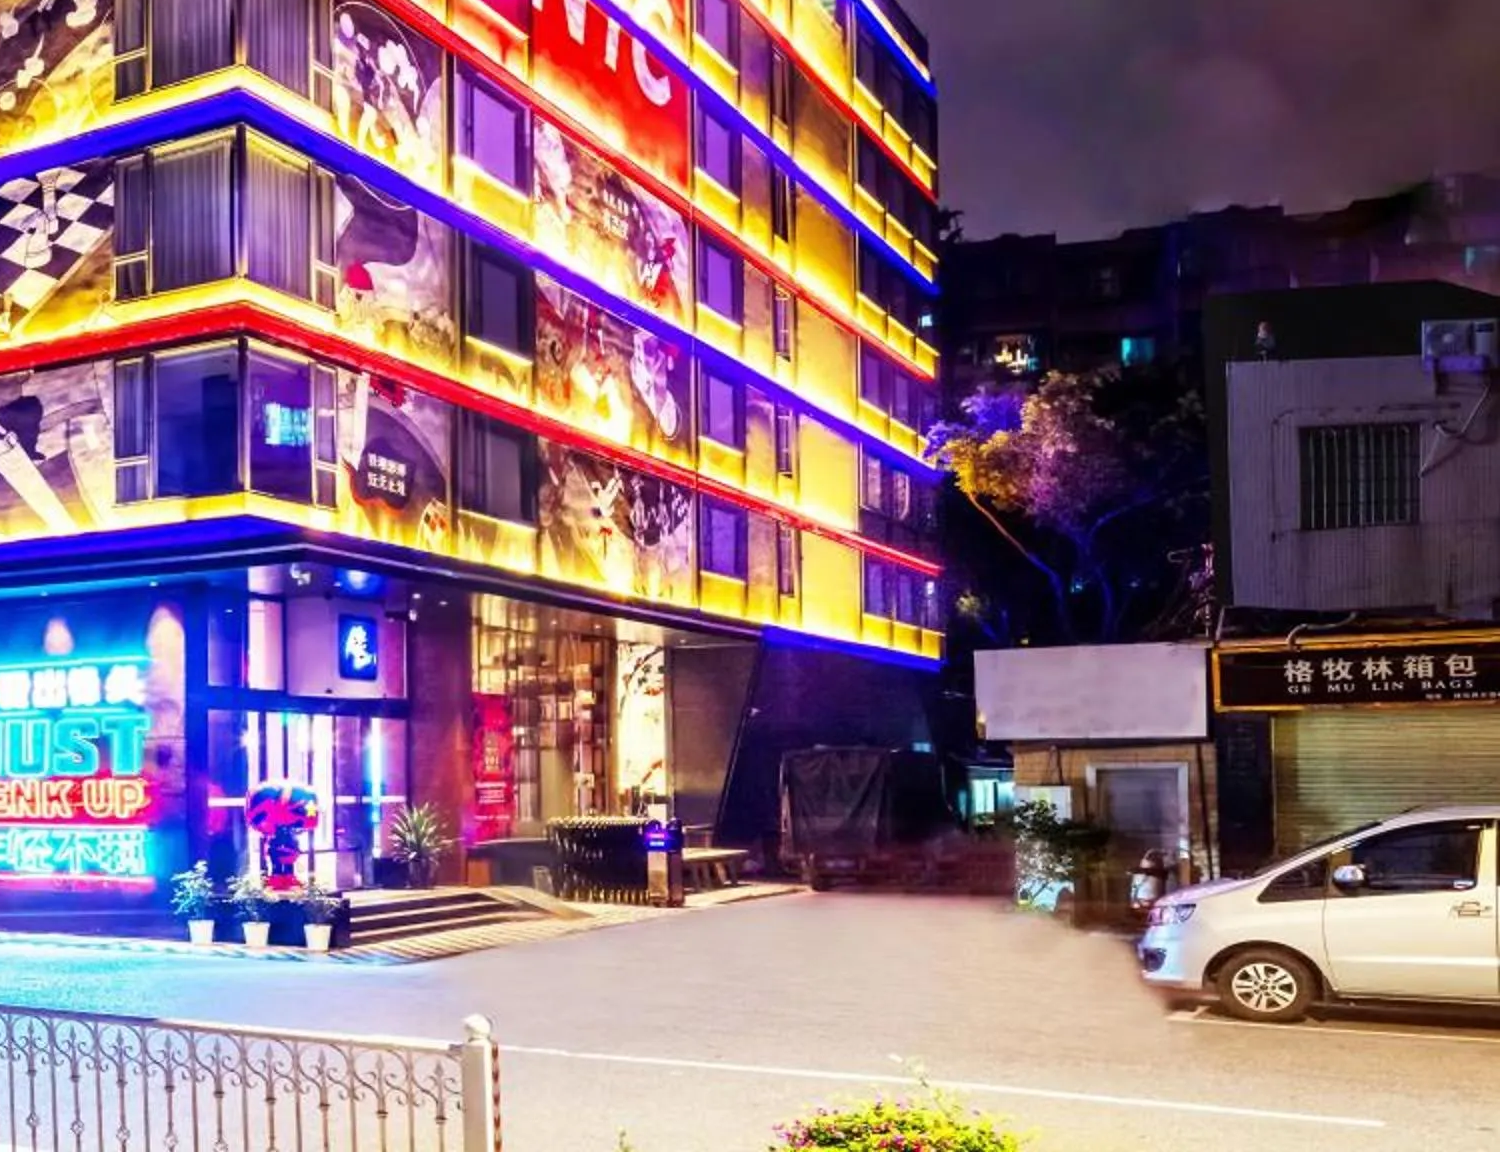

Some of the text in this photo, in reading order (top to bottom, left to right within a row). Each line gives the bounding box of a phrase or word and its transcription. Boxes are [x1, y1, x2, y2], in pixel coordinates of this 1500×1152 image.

[1284, 654, 1477, 684] 格牧林箱包
[1287, 679, 1474, 694] GE MU LIN BAGS
[82, 777, 150, 819] UP
